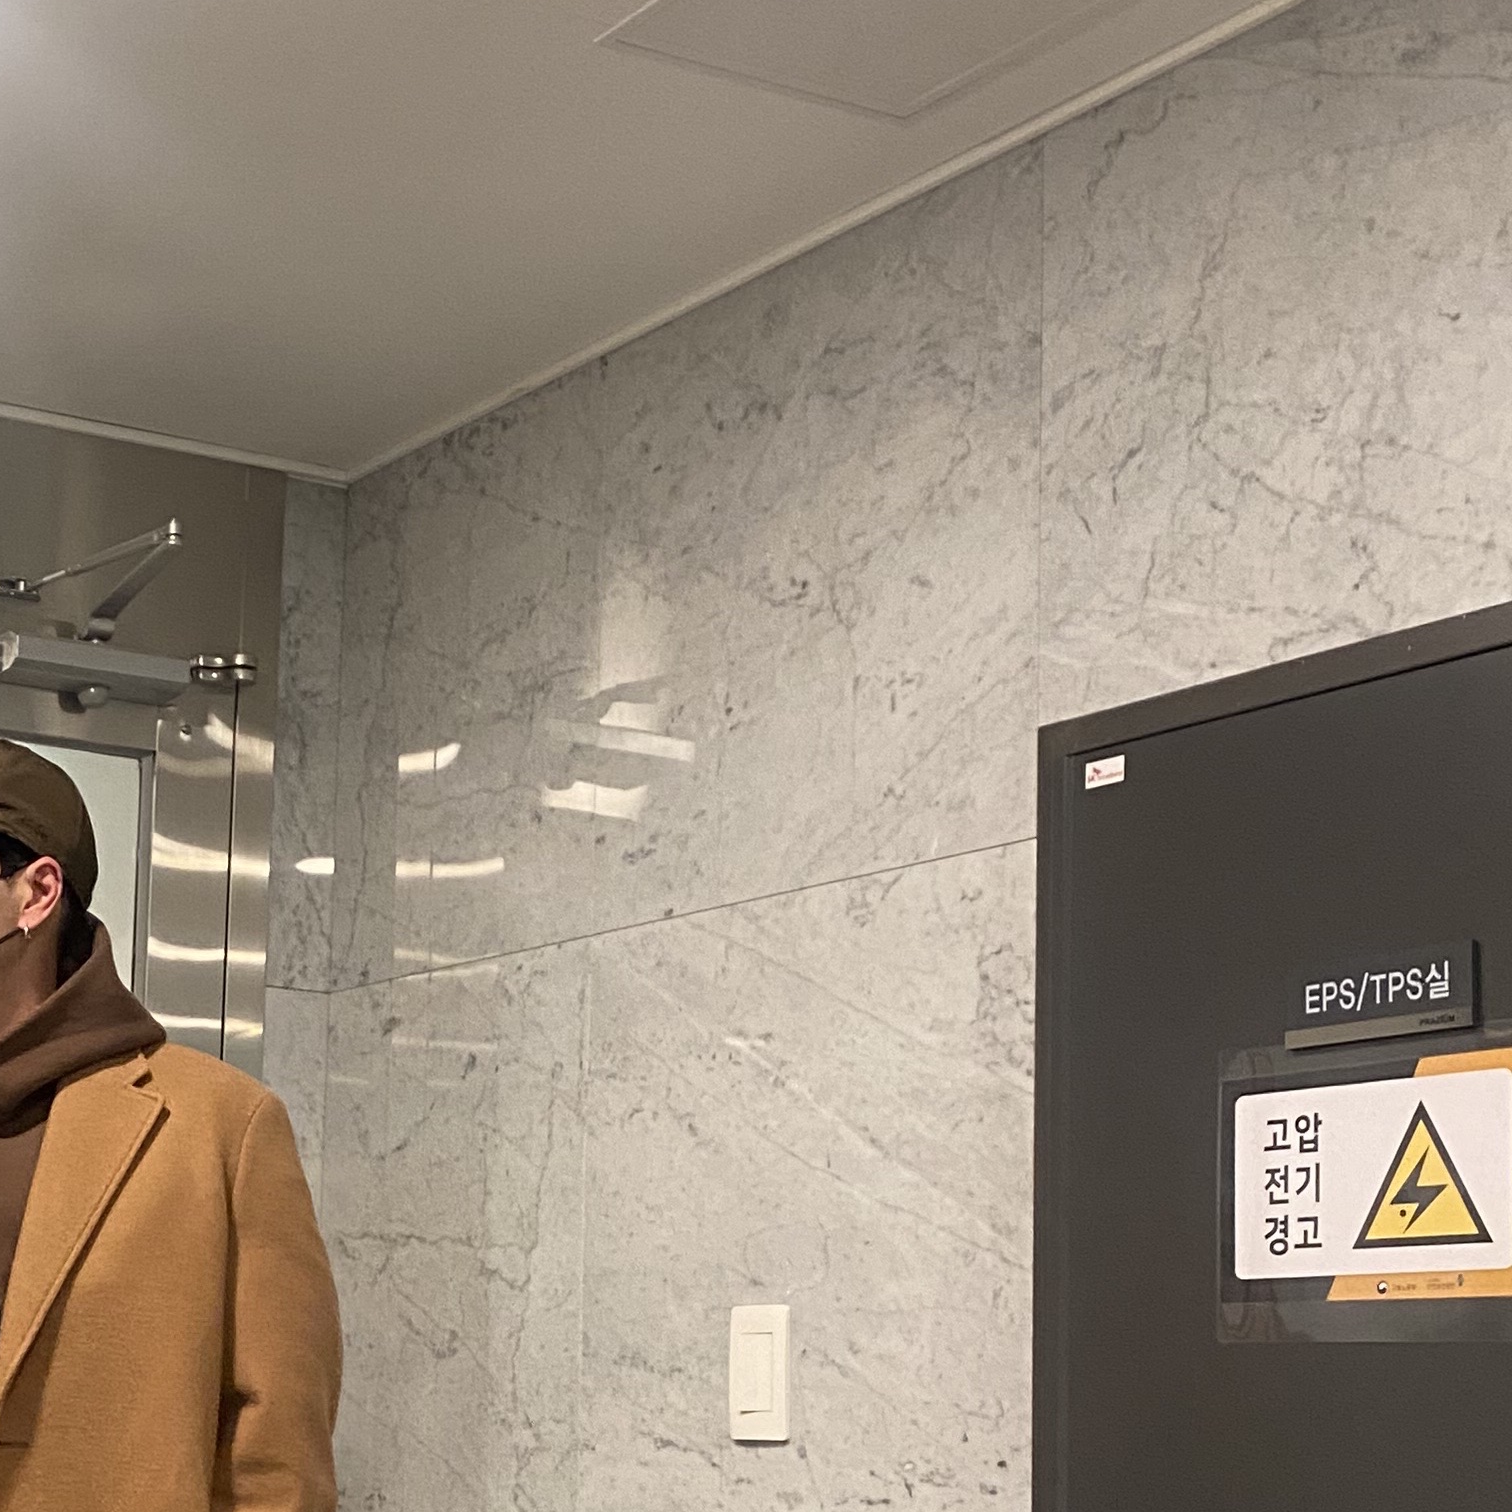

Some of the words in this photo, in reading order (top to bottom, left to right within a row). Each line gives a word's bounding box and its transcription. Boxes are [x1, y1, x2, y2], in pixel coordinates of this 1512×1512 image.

[1304, 960, 1450, 1014] EPS/TPS실
[1263, 1112, 1323, 1154] 고압
[1264, 1162, 1321, 1205] 전기
[1264, 1214, 1323, 1256] 경고
